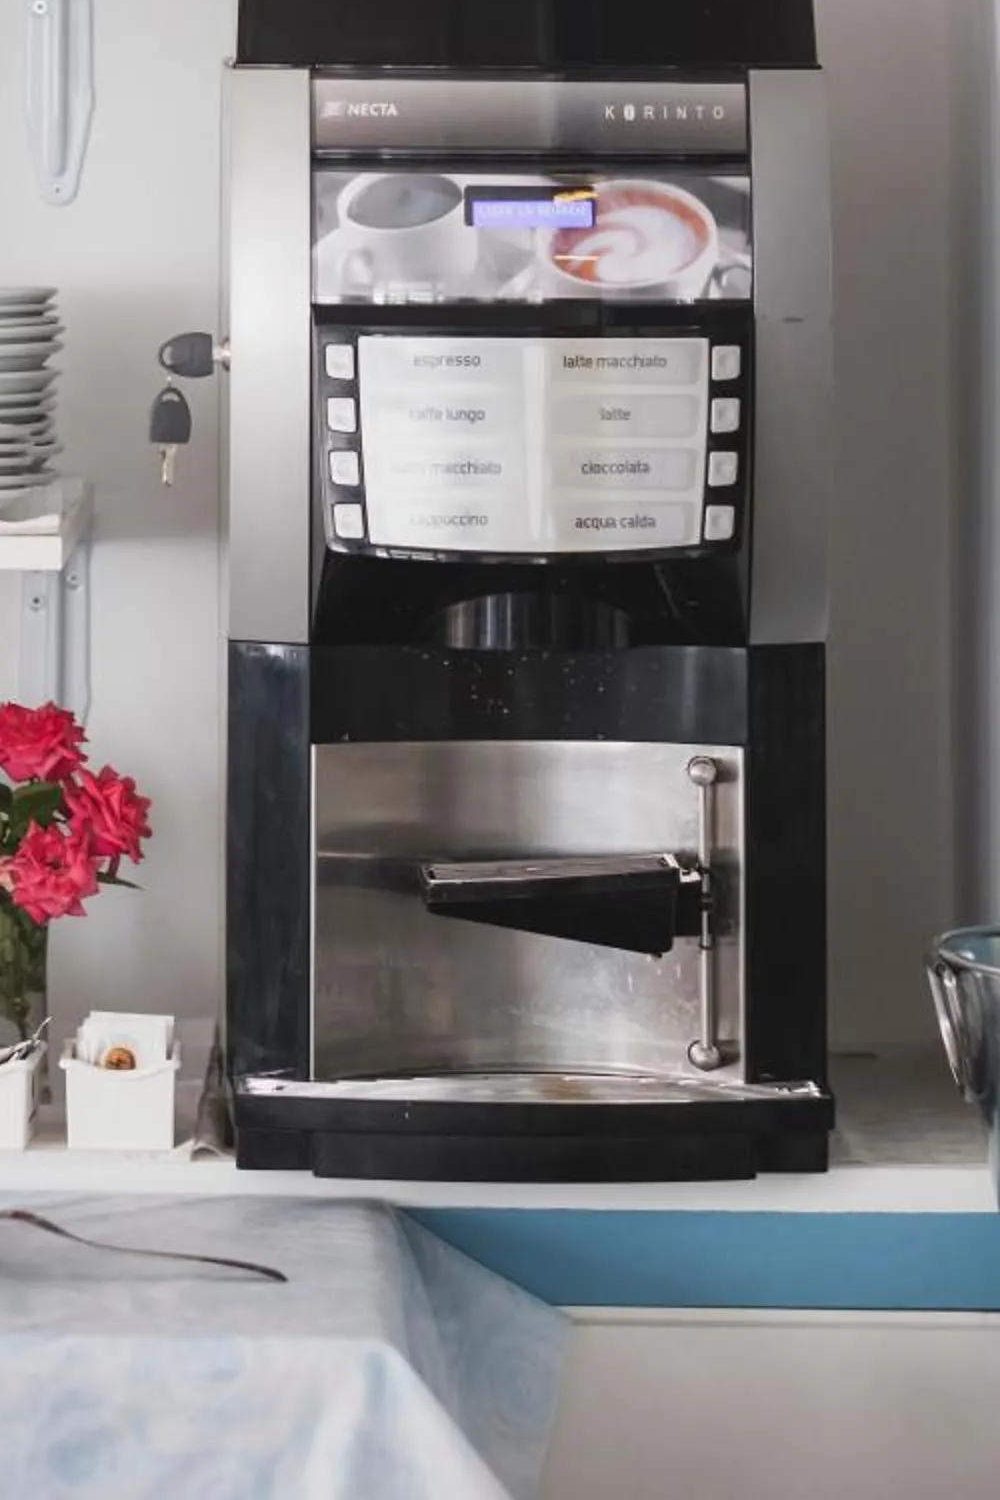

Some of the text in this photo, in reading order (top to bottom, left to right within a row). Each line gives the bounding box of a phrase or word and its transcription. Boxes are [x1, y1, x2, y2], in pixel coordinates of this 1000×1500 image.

[346, 102, 399, 117] NECTA
[604, 103, 725, 121] KORINTO
[413, 354, 481, 369] espresso
[596, 355, 668, 369] macchiato
[445, 407, 486, 425] lungo
[581, 459, 651, 475] cioccolata
[574, 512, 657, 531] acqua calda
